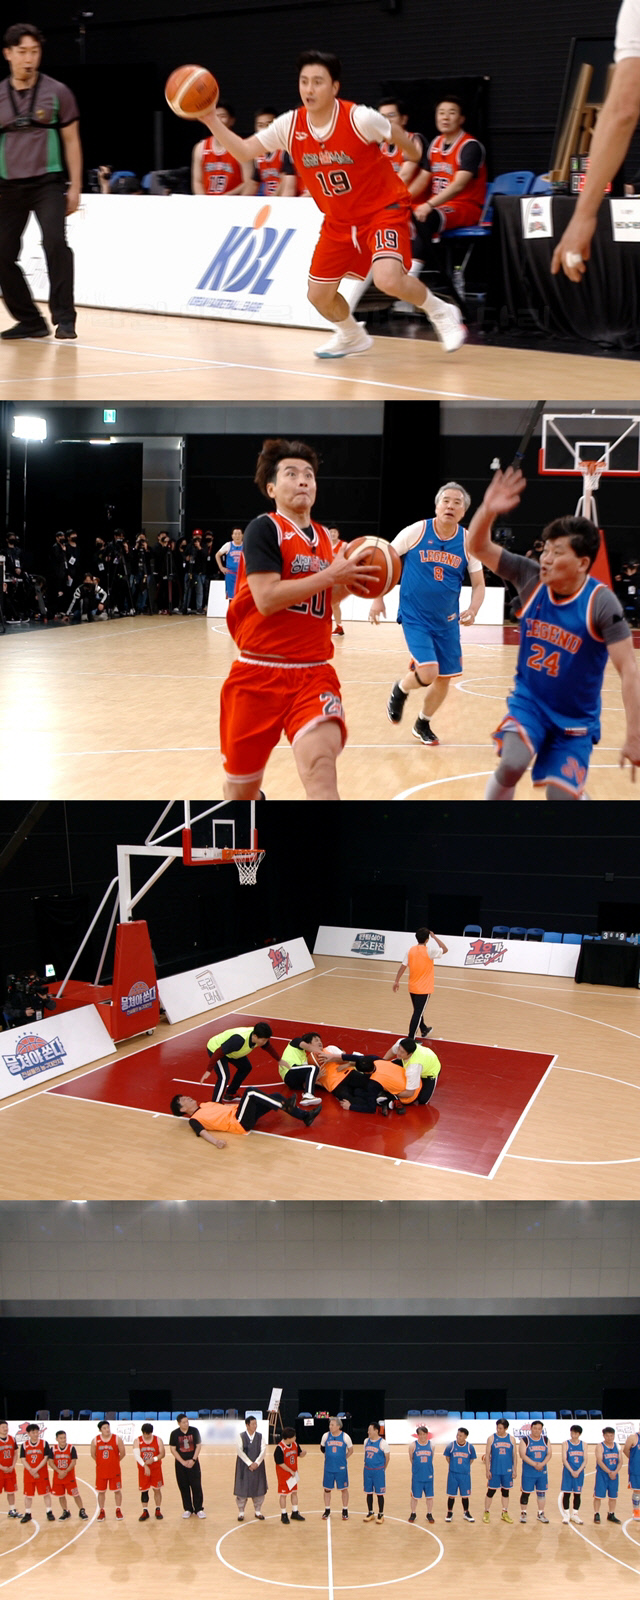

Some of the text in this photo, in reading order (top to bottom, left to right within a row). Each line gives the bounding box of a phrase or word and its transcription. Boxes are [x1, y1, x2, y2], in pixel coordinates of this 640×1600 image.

[315, 169, 352, 198] 19
[374, 229, 399, 251] 19
[195, 226, 297, 295] KBL
[418, 550, 462, 569] LEGEND
[433, 566, 444, 582] 8
[525, 617, 583, 655] LEGEND
[526, 643, 561, 678] 24
[3, 1037, 67, 1075] 뭉쳐야 쏜다
[31, 1455, 38, 1464] 7
[102, 1450, 110, 1460] 9
